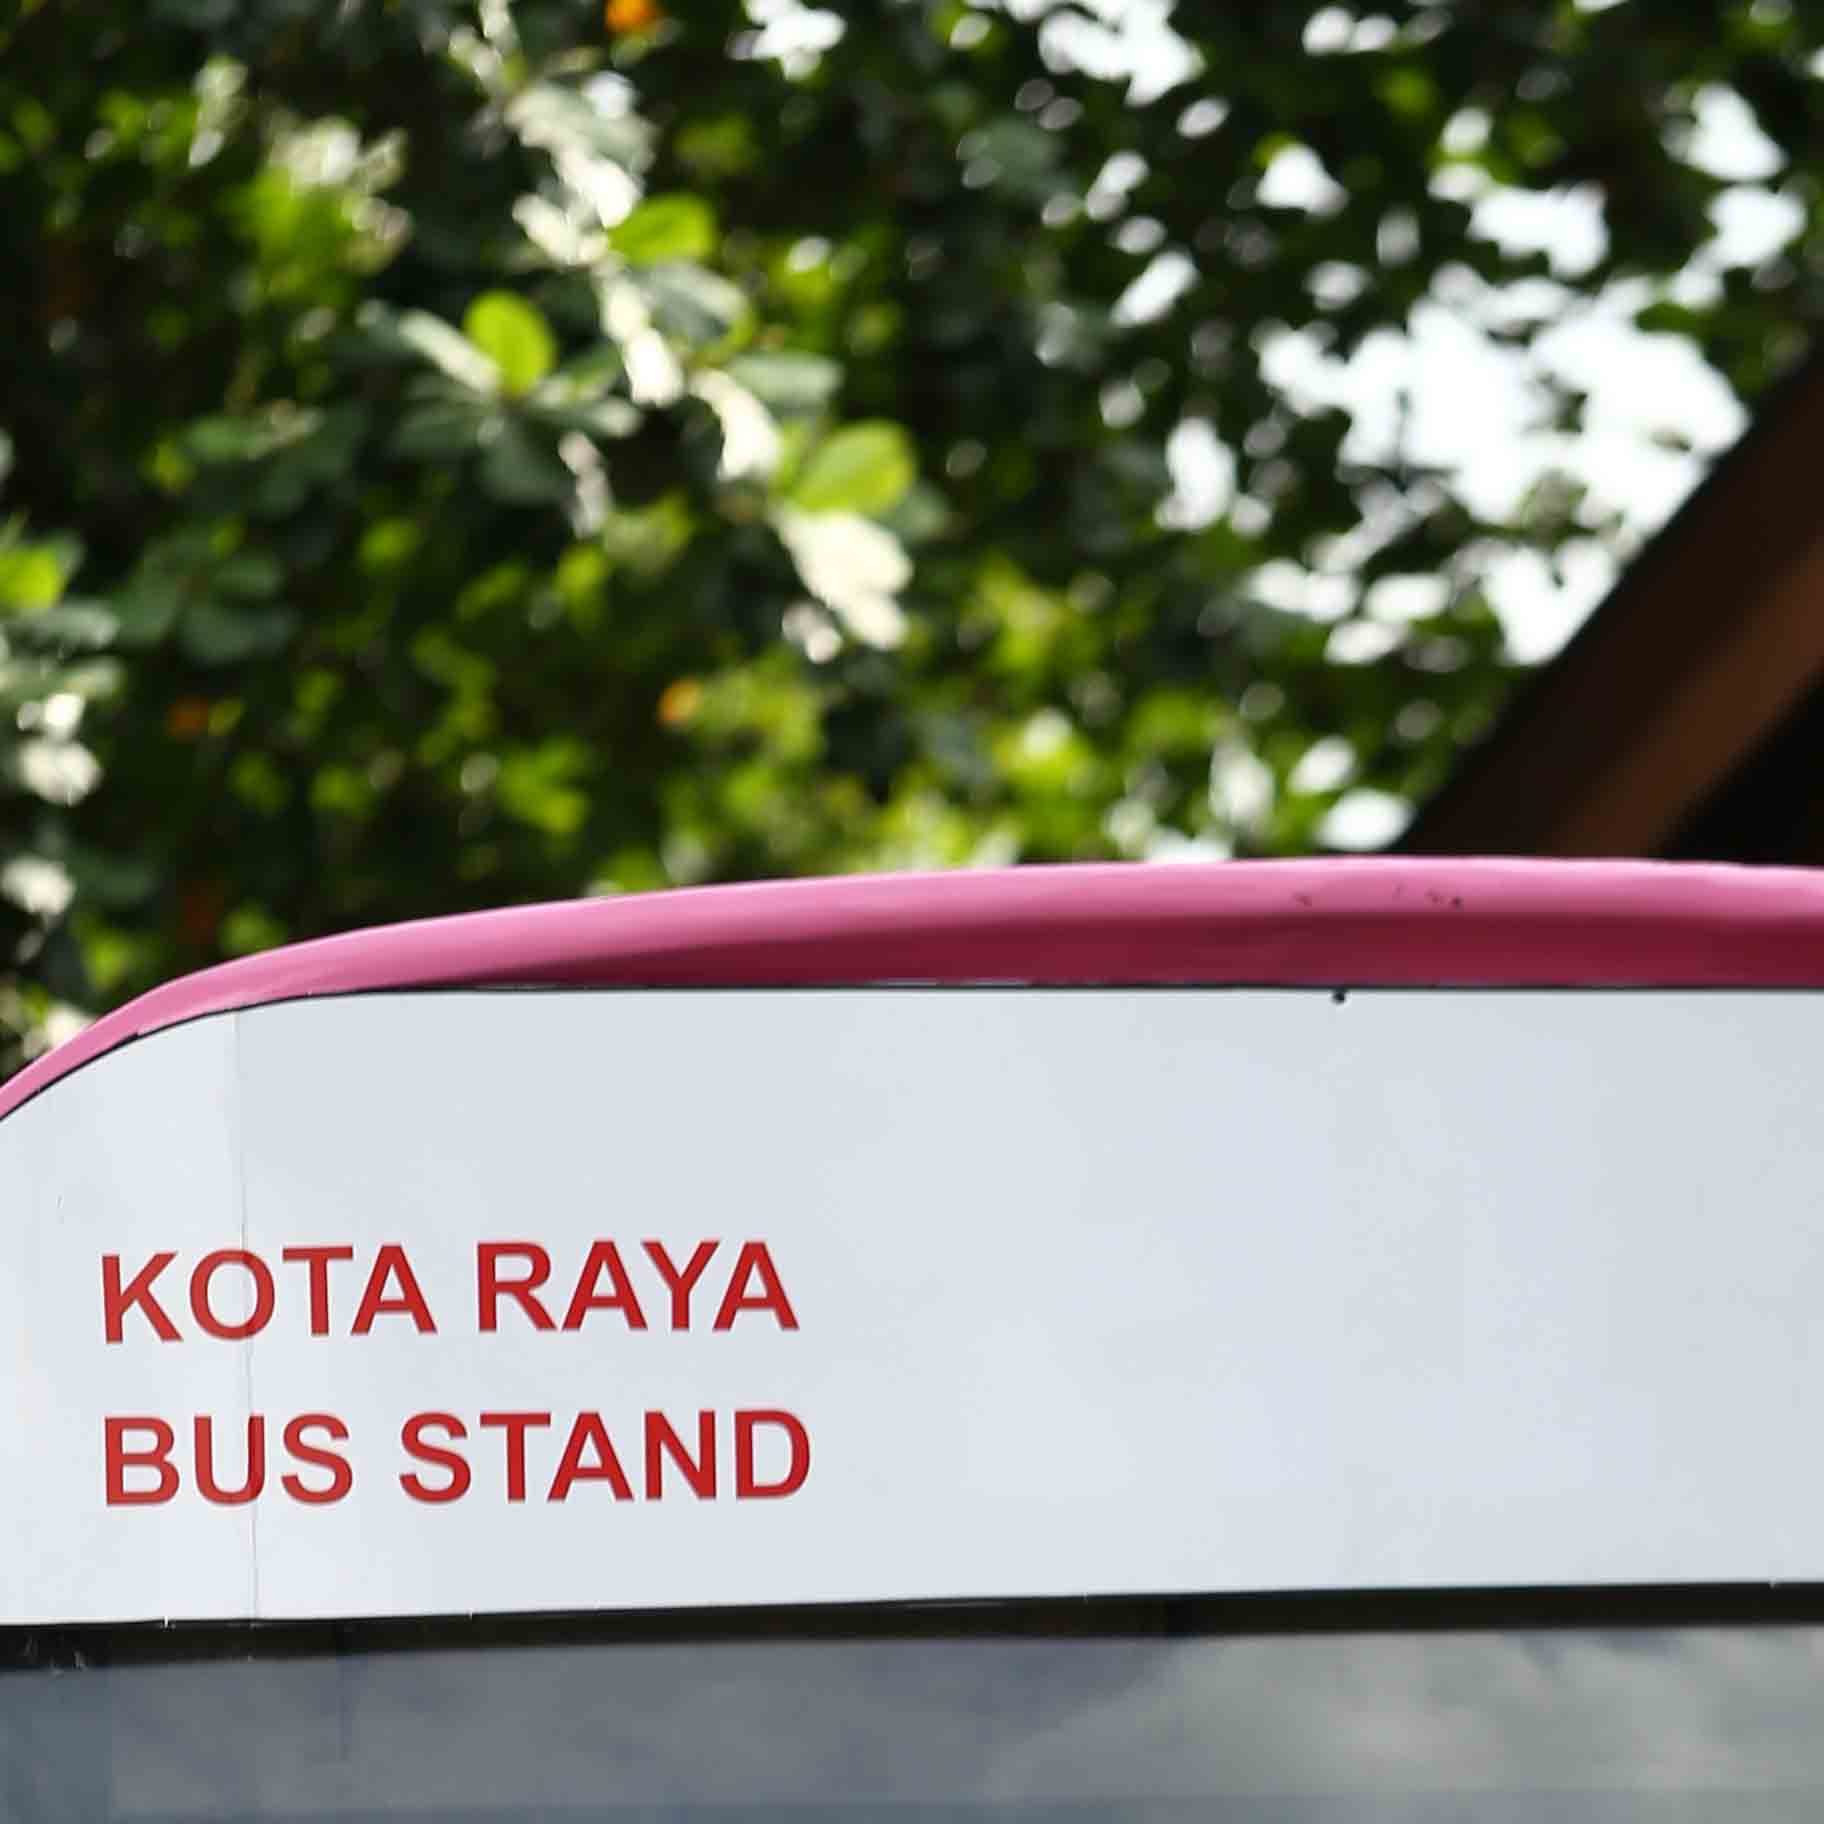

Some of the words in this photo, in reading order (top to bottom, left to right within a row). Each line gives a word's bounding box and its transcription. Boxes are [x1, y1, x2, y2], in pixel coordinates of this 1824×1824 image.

[102, 1244, 437, 1345] KOTA
[476, 1240, 800, 1333] RAYA
[104, 1411, 353, 1506] BUS
[400, 1408, 811, 1504] STAND
